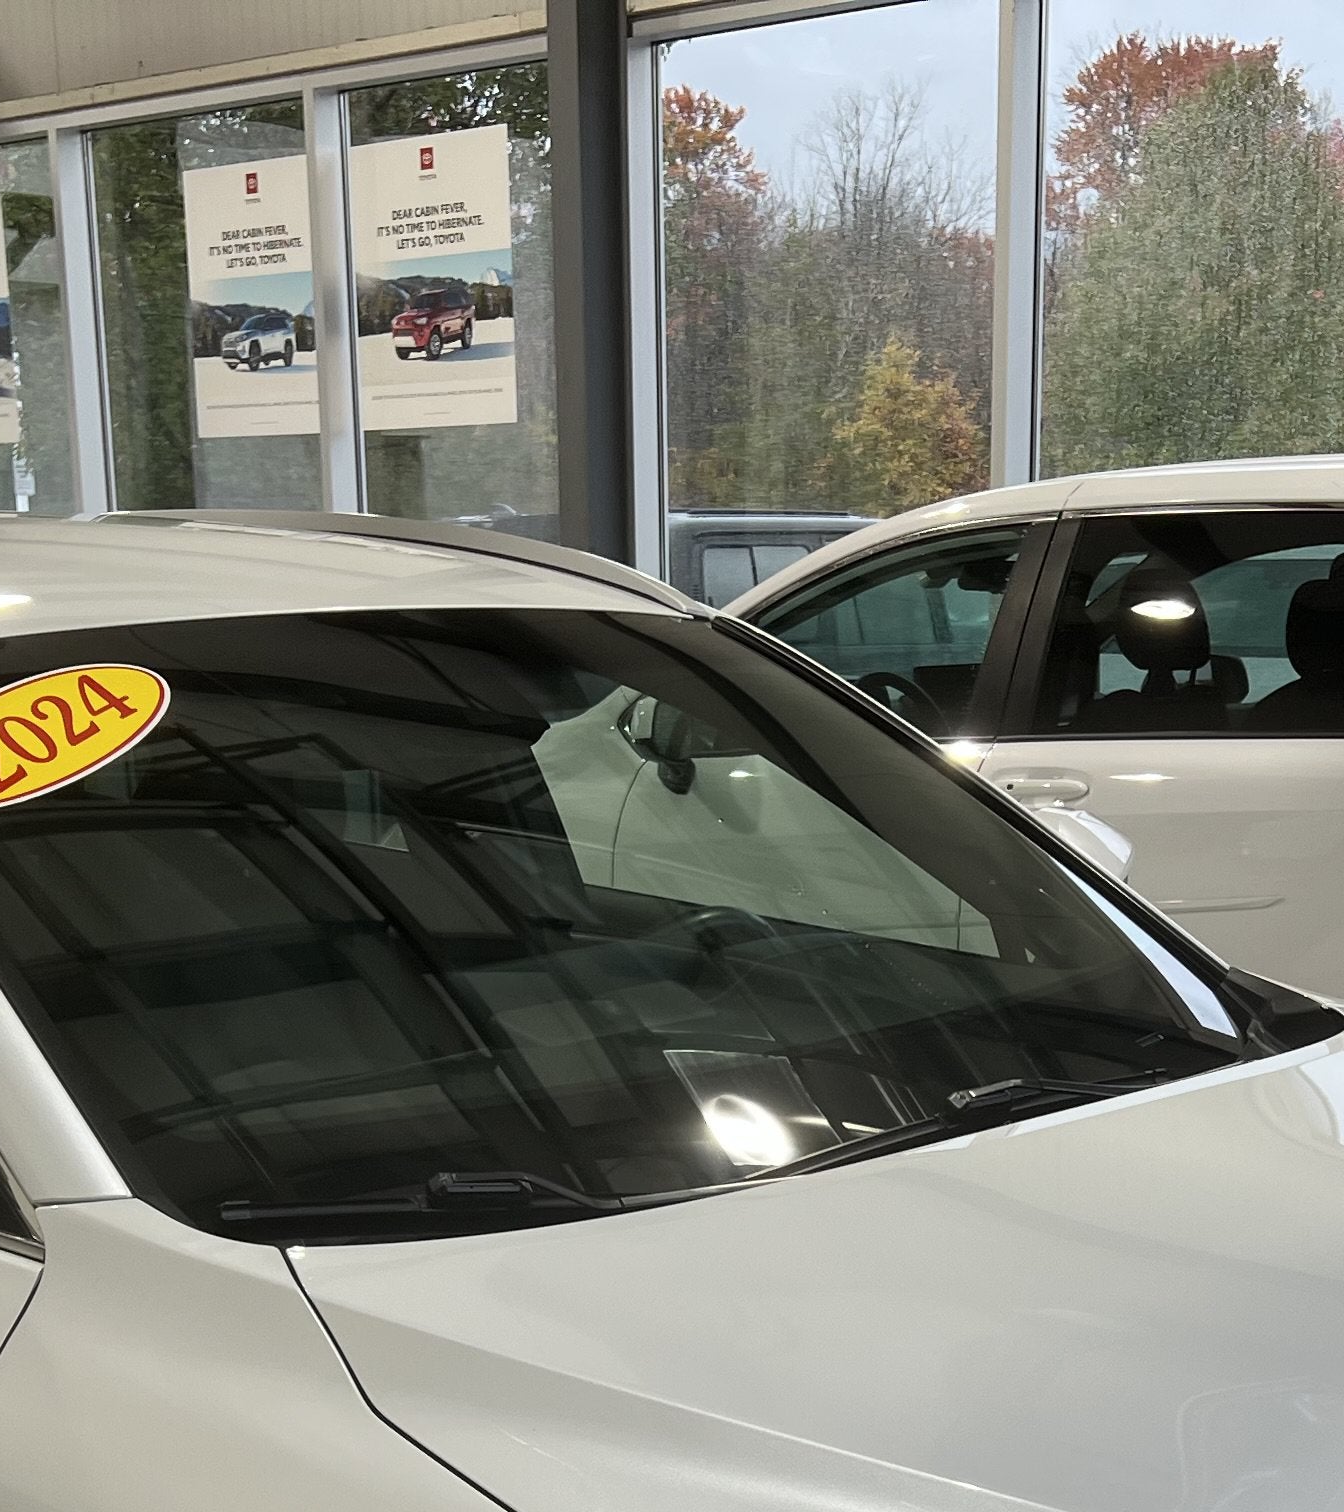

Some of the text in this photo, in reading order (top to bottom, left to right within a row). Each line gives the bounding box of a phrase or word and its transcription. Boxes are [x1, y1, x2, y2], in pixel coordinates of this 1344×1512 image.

[392, 201, 468, 221] DEAR CABIN FEVER,
[377, 226, 391, 237] IT'S
[392, 224, 405, 235] NO
[406, 222, 424, 234] TIME
[426, 220, 437, 231] TO
[397, 232, 465, 250] LET'S GO, TOYOTA
